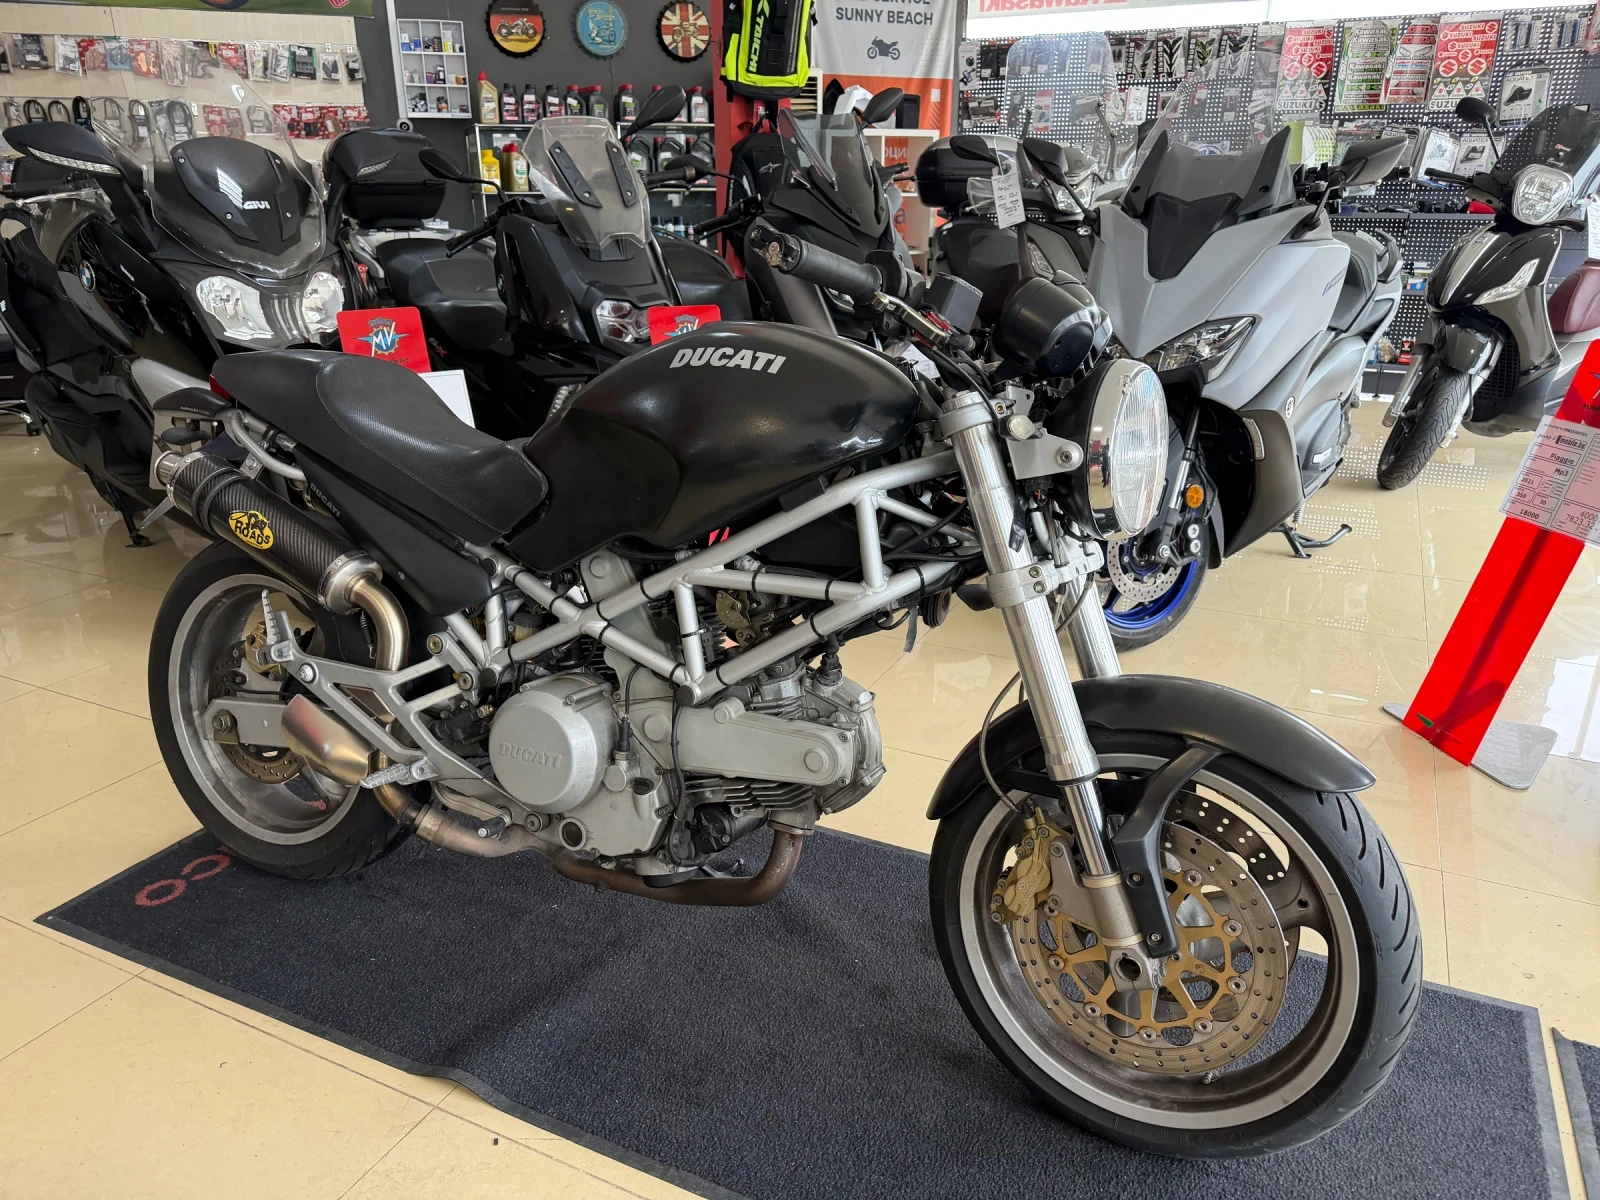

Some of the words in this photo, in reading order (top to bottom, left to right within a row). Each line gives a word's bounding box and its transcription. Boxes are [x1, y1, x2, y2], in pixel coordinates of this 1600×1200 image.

[836, 7, 884, 22] SUNNY
[887, 10, 933, 25] BEACH
[748, 15, 765, 72] TAICHI
[1277, 100, 1314, 109] SUZUKI
[1429, 100, 1458, 109] SUZU
[243, 200, 271, 210] GIVI
[371, 322, 395, 357] MV
[669, 347, 786, 374] DUCATI
[1559, 437, 1585, 450] mobile.bg
[1549, 453, 1575, 465] Piaggio
[1553, 467, 1569, 477] Mp3
[1521, 477, 1534, 485] 2021
[310, 482, 340, 517] DUCATI
[1519, 508, 1540, 520] 18000
[1564, 514, 1595, 530] 7823.32
[234, 520, 271, 545] ROADS
[499, 742, 562, 769] DUCATI
